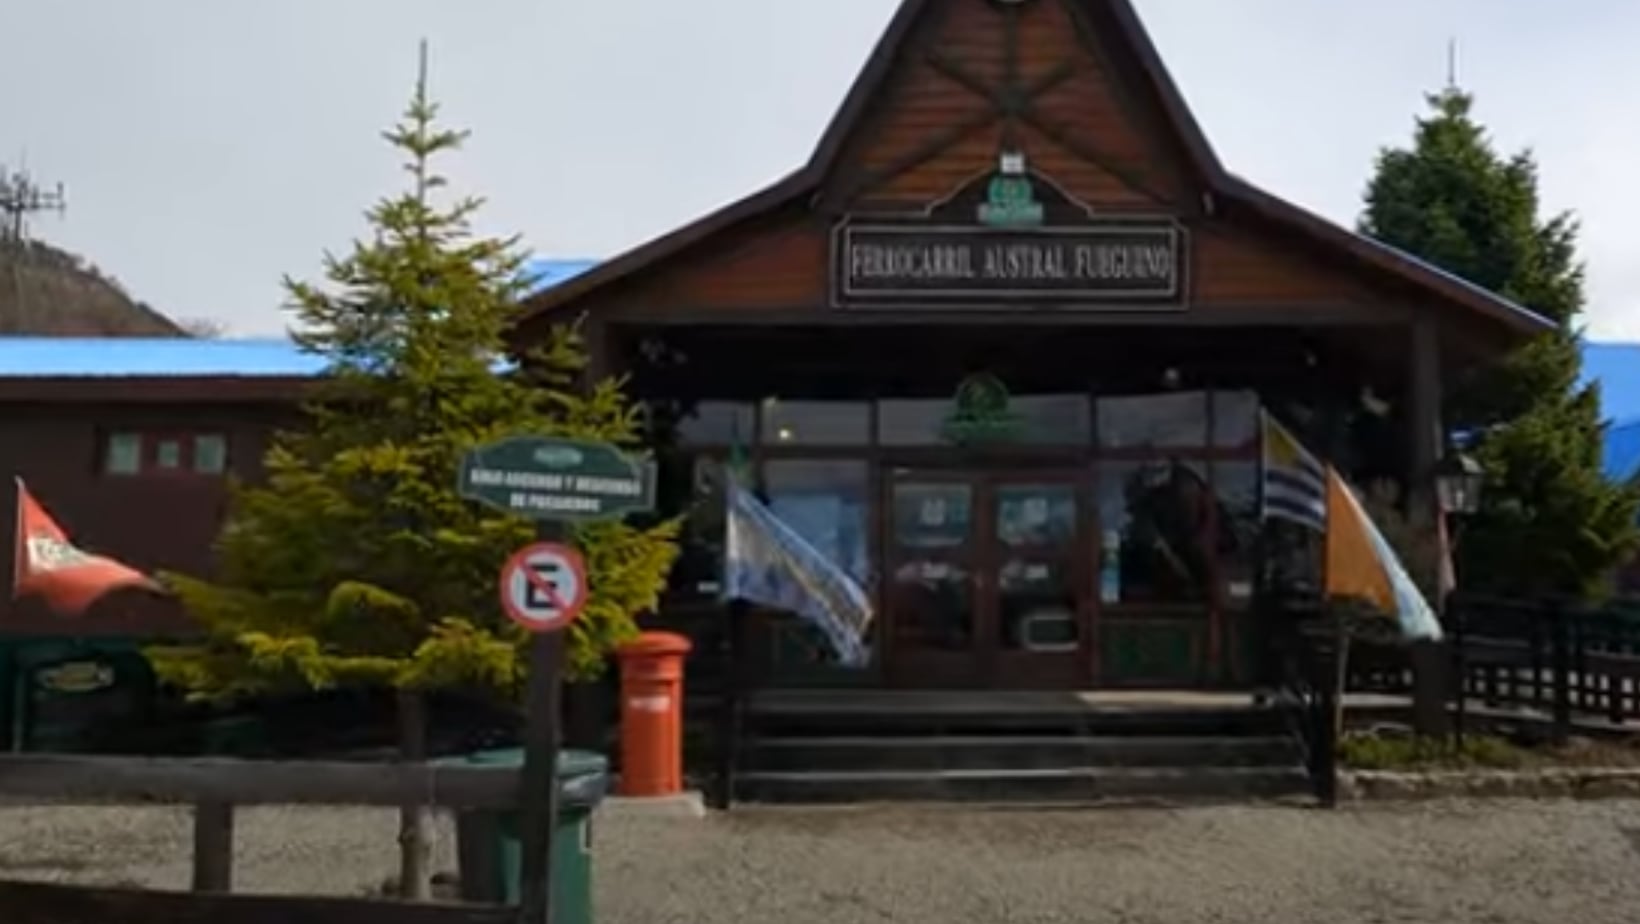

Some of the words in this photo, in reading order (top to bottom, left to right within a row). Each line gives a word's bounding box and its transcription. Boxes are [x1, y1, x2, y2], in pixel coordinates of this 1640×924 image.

[852, 245, 975, 278] FERROCARRIL
[984, 245, 1066, 278] AUSTRAL
[1075, 245, 1170, 279] FUEGUINO
